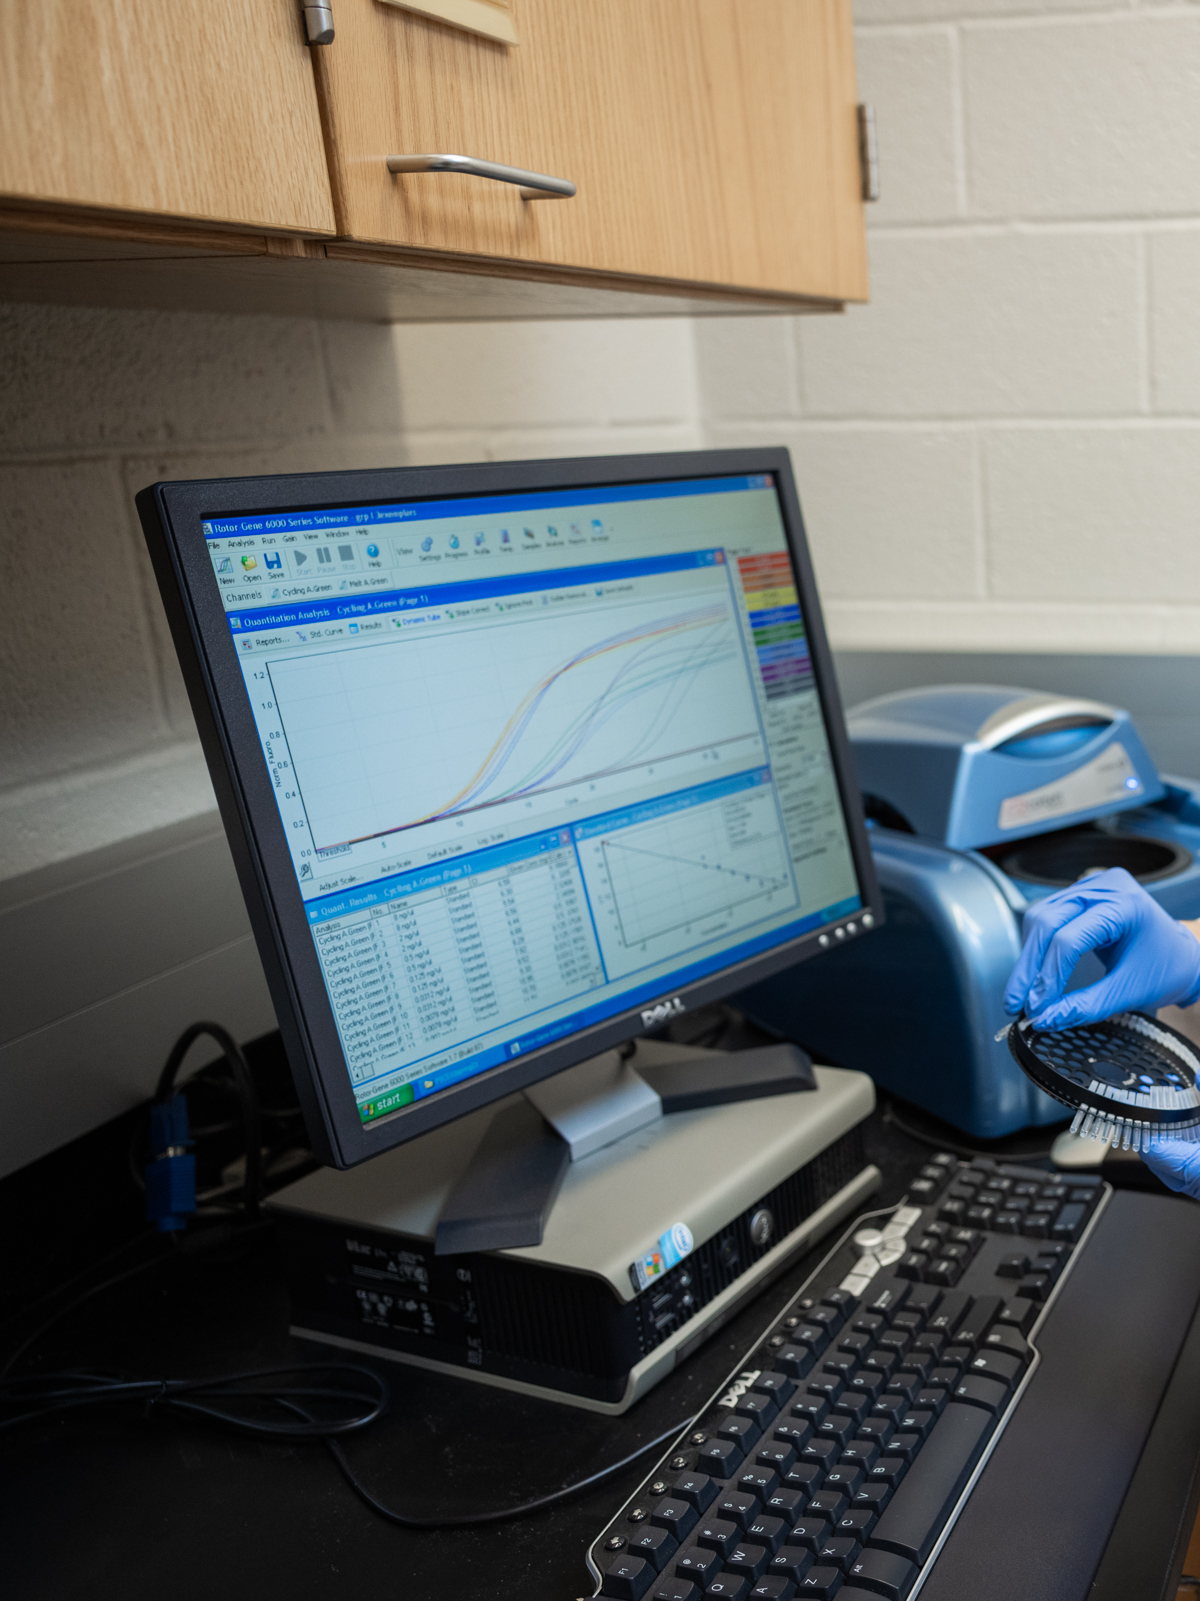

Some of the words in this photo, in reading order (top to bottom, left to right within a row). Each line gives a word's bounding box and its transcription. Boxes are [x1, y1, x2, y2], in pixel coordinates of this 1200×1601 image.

[265, 519, 286, 528] 6000
[288, 517, 313, 526] Series
[314, 515, 348, 524] Software
[228, 539, 255, 548] Analysis
[355, 528, 369, 536] Help
[243, 574, 261, 584] Open
[226, 591, 262, 602] Channels
[282, 586, 305, 597] Cycling
[244, 614, 296, 627] Quantitation
[298, 609, 330, 620] Analysis
[337, 603, 366, 615] Cycling
[325, 627, 343, 636] Curve
[360, 622, 382, 630] Results
[278, 761, 288, 769] 0.6
[285, 791, 296, 799] 0.4
[301, 849, 312, 857] 0.0
[319, 844, 350, 858] Threshold
[319, 880, 339, 892] Adjust
[321, 904, 348, 916] Quant.
[350, 893, 377, 906] Results
[384, 883, 412, 897] Cycling
[390, 900, 408, 910] Name
[315, 922, 341, 933] Analysis
[319, 933, 341, 945] Cycling
[321, 944, 344, 956] Cycling
[324, 955, 346, 967] Cycling
[327, 965, 349, 977] Cycling
[330, 976, 352, 988] Cycling
[333, 987, 355, 999] Cycling
[335, 998, 358, 1010] Cycling
[339, 1008, 361, 1020] Cycling
[641, 997, 686, 1029] DELL
[341, 1019, 364, 1031] Cycling
[344, 1030, 366, 1042] Cycling
[347, 1040, 369, 1052] Cycling
[350, 1051, 372, 1063] Cycling
[390, 1076, 405, 1086] 6000
[406, 1069, 423, 1080] Series
[424, 1059, 447, 1073] Software
[377, 1093, 400, 1111] start
[717, 1370, 761, 1408] DELL
[732, 1551, 746, 1561] W
